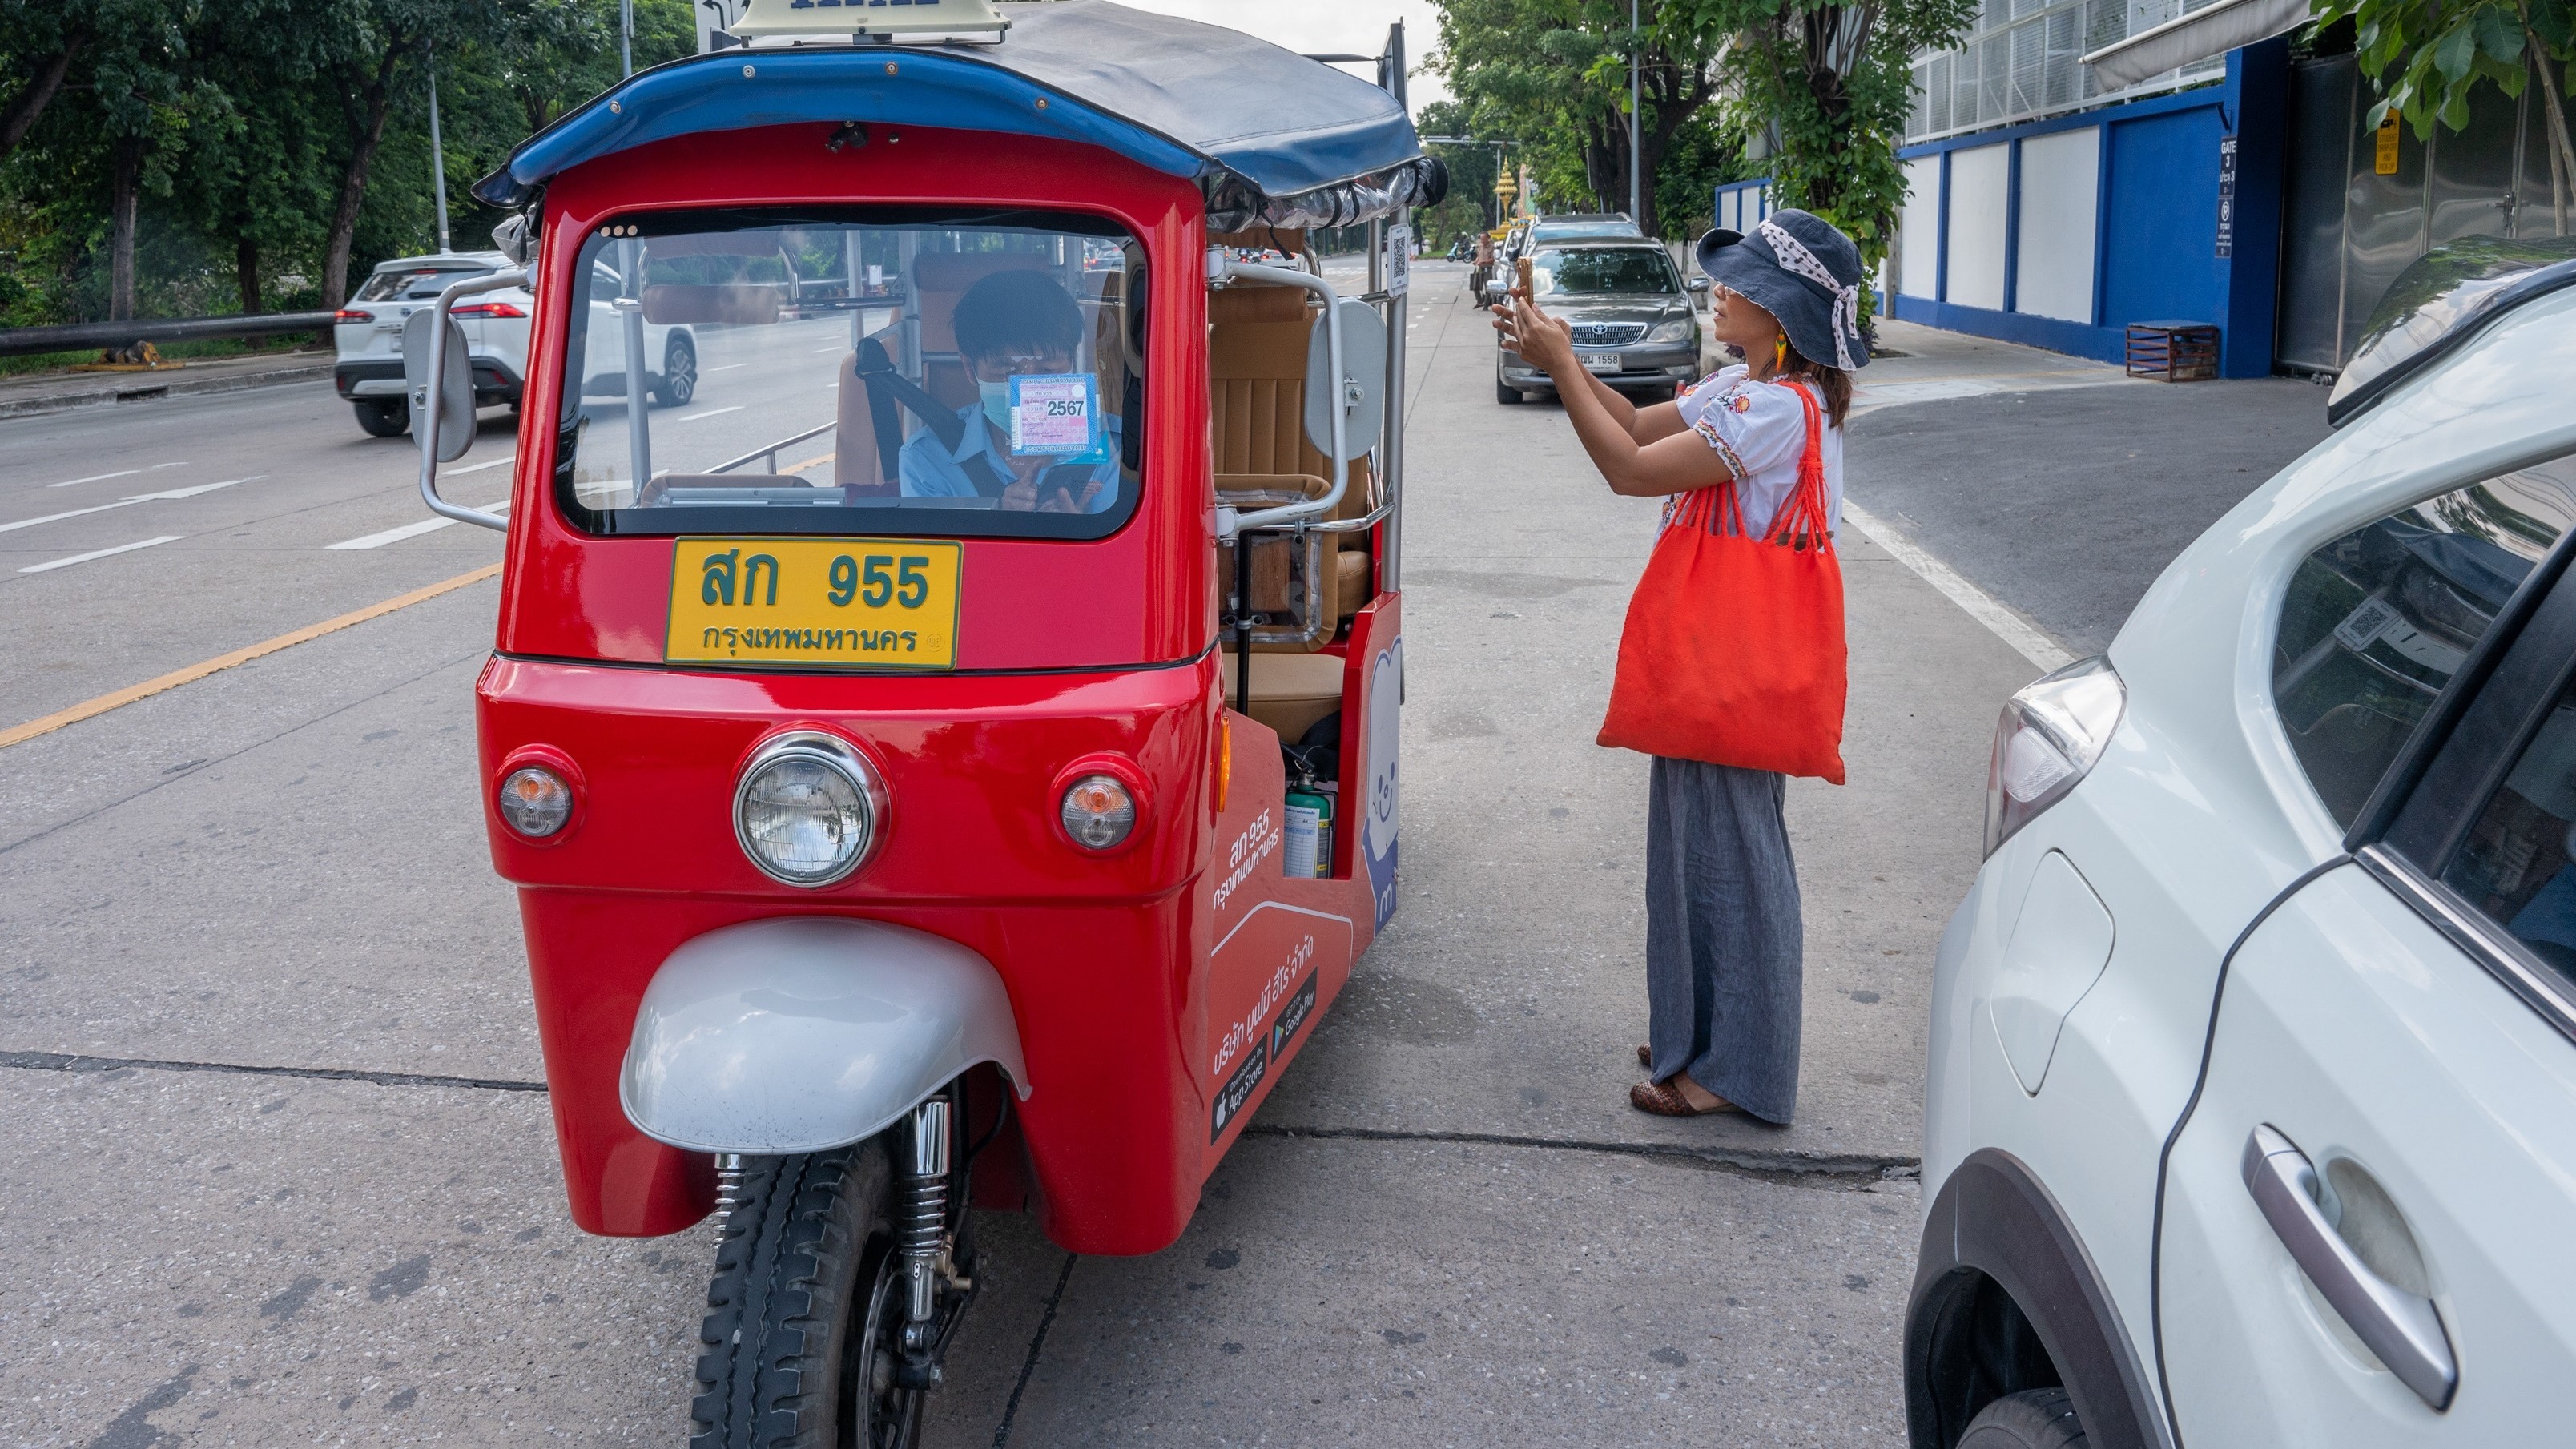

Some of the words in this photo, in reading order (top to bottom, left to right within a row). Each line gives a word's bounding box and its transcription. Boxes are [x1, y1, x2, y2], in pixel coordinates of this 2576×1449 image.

[2221, 141, 2236, 154] GATE
[2225, 155, 2230, 167] 3
[2230, 170, 2235, 182] 3
[1598, 355, 1618, 364] 1558
[1047, 400, 1085, 417] 2567
[702, 547, 779, 606] สก
[827, 554, 929, 609] 955
[703, 626, 918, 656] กรุงเทพมหานคร
[1230, 831, 1248, 869] สก
[1249, 807, 1270, 849] 955
[1214, 827, 1278, 910] กรุงเทพมหานคร
[1214, 1021, 1245, 1075] บริษัท
[1291, 934, 1314, 978] จำกัด
[1286, 1004, 1303, 1036] Google
[1303, 990, 1314, 1012] Play
[1228, 1086, 1244, 1115] App
[1244, 1061, 1262, 1094] Store
[1230, 1059, 1250, 1092] Download
[1250, 1055, 1257, 1065] on
